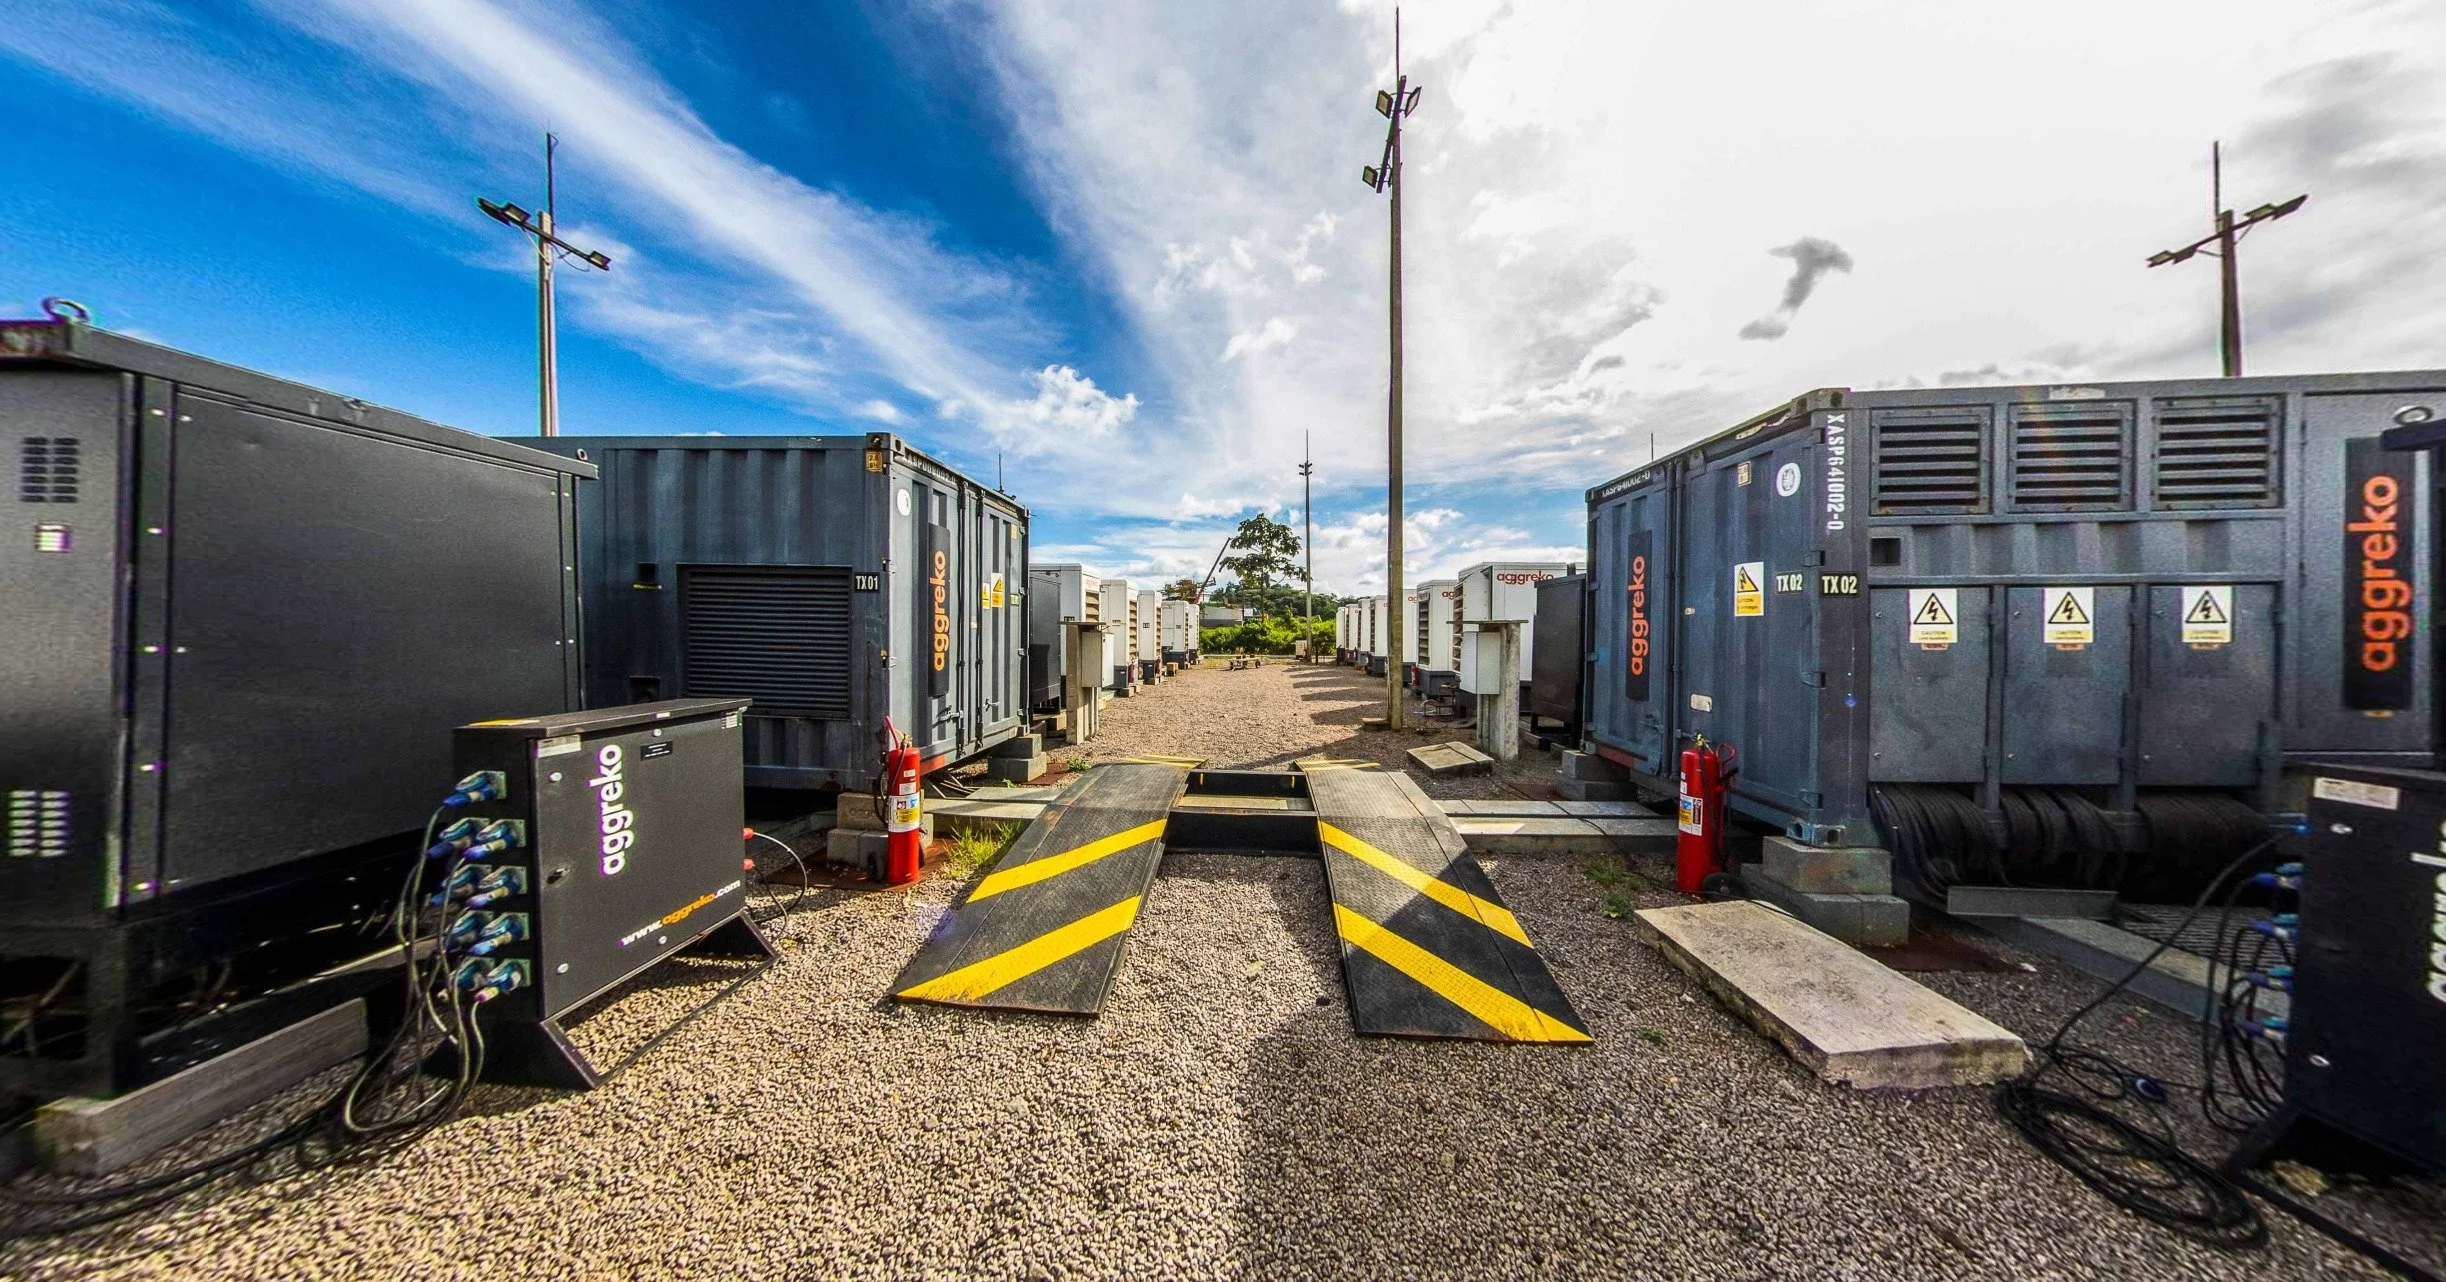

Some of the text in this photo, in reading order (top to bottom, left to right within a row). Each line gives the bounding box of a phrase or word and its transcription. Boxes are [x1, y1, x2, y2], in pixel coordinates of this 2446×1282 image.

[930, 551, 949, 671] aggreko
[1628, 556, 1649, 675] aggreko
[2343, 475, 2412, 671] aggreko
[588, 744, 634, 875] aggreko
[618, 880, 741, 947] www.aggreko.com
